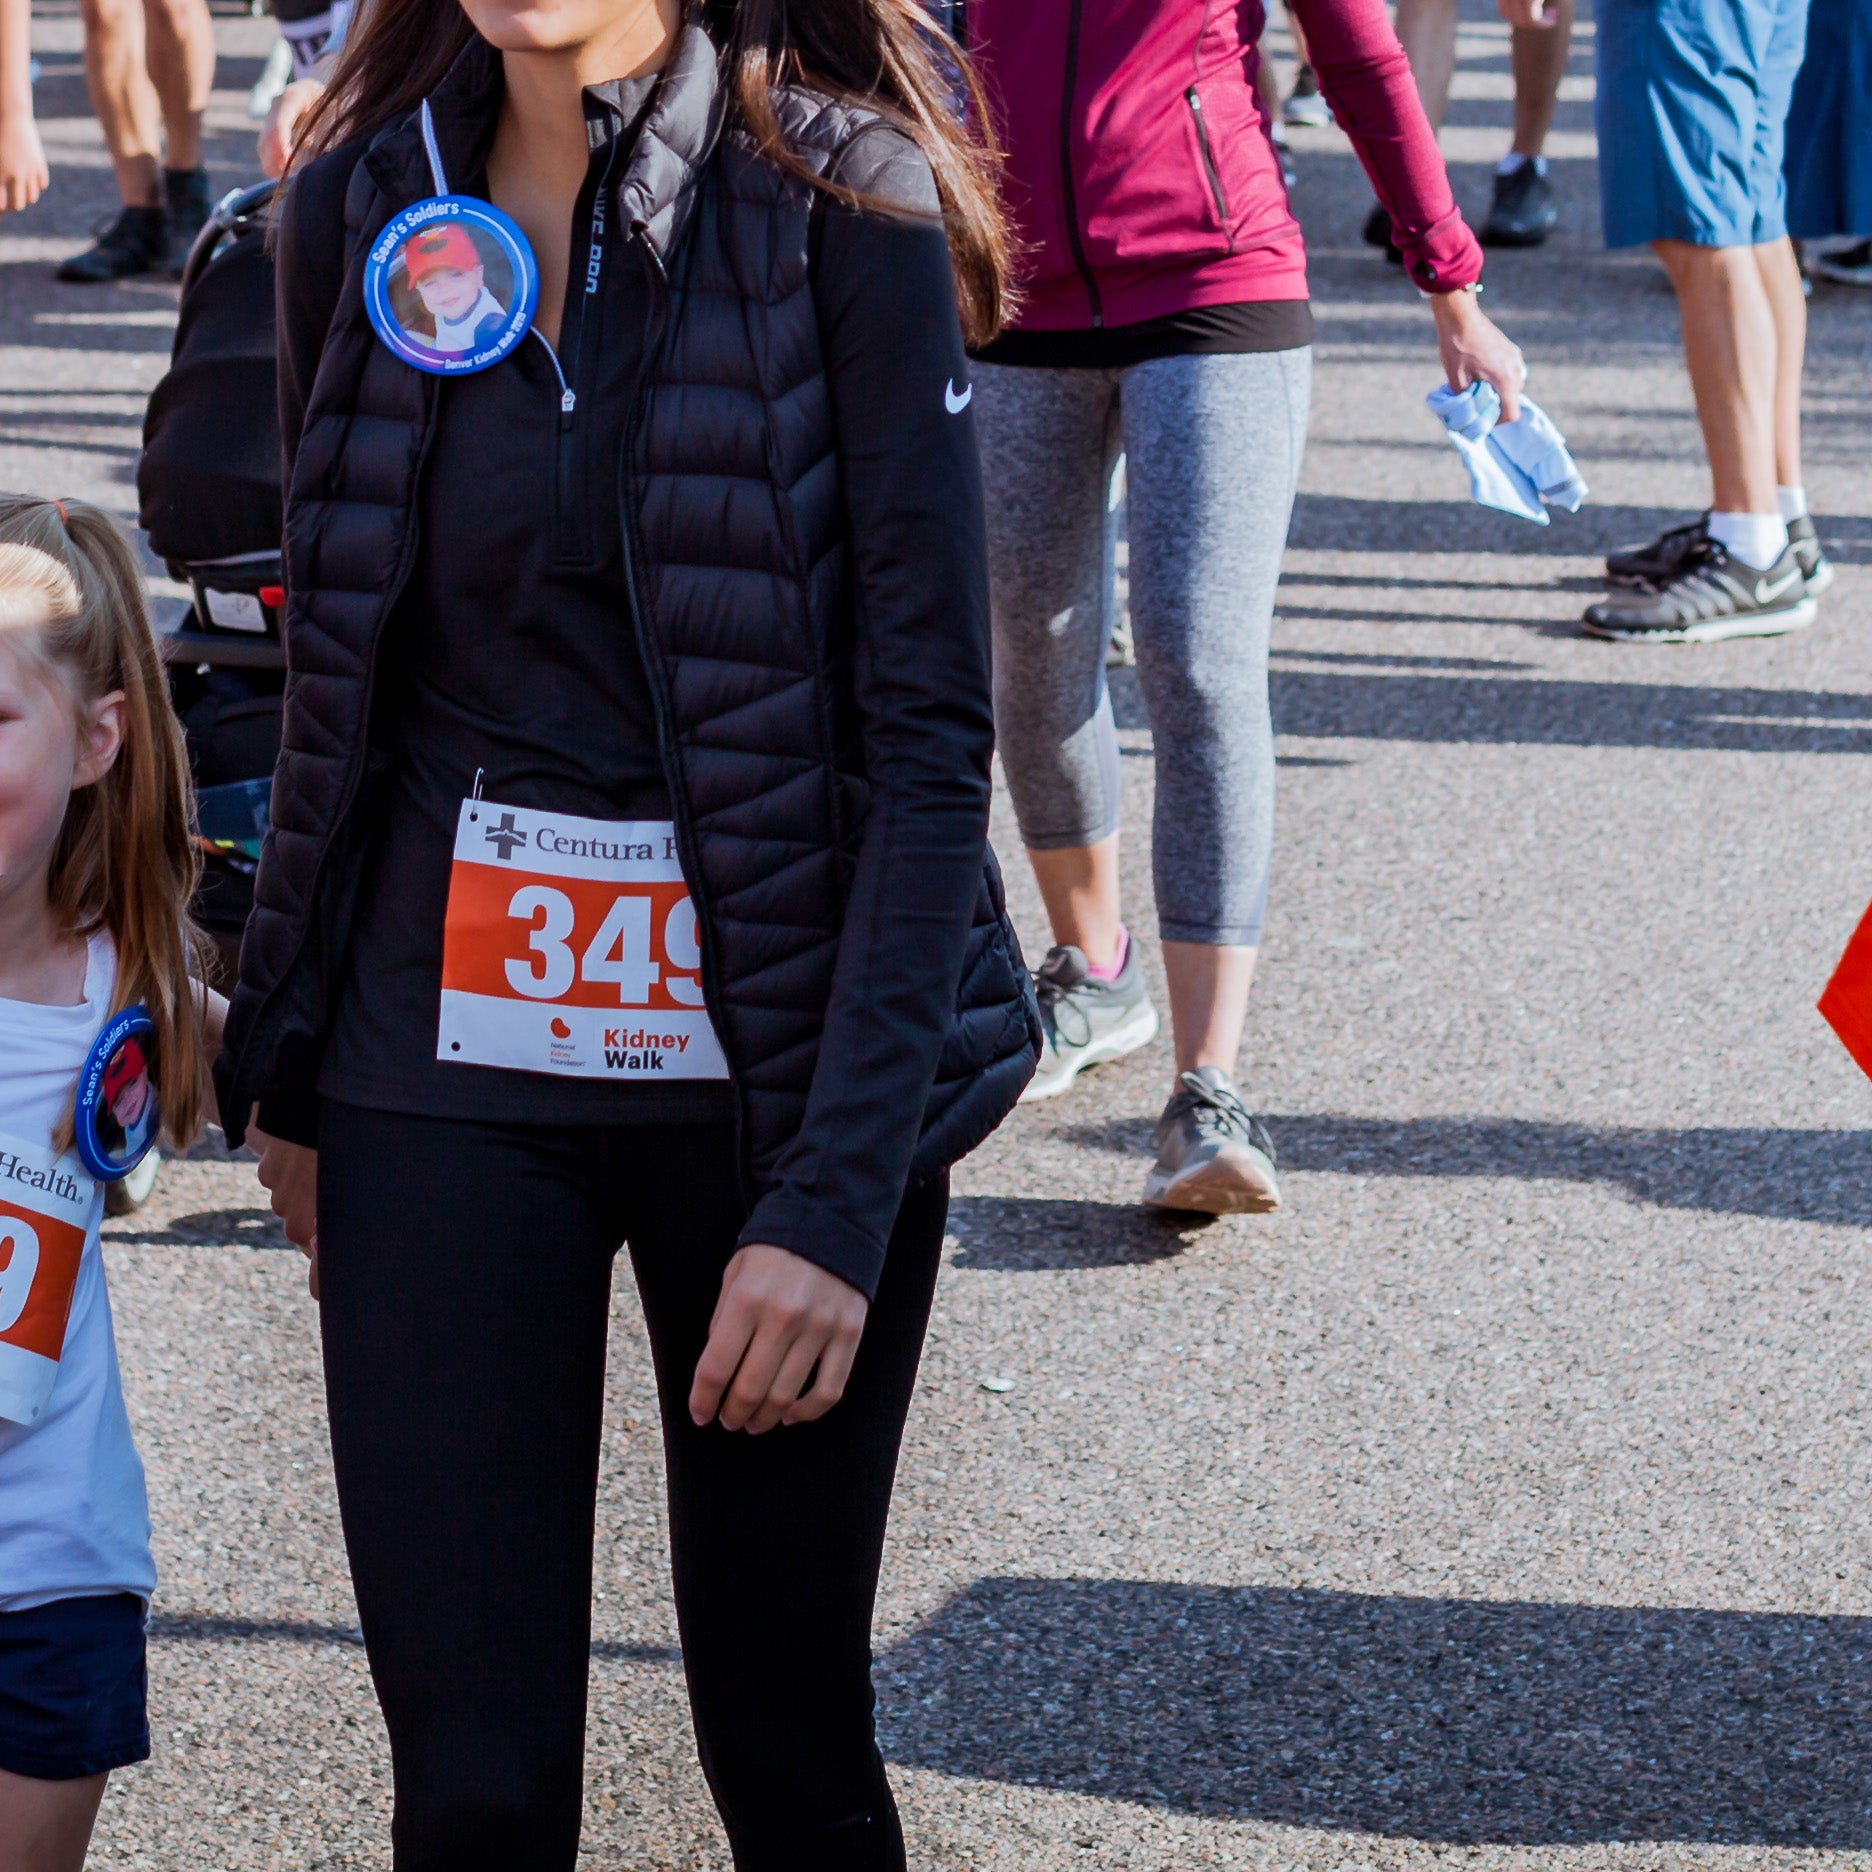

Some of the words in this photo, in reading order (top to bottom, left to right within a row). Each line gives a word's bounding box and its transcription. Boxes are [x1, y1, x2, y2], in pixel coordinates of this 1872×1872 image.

[372, 225, 407, 264] Sean's
[404, 202, 460, 227] Soldiers
[536, 828, 654, 861] Centura
[504, 885, 707, 1006] 349
[82, 1061, 103, 1105] Sean's
[98, 1018, 130, 1059] Soldiers
[604, 1028, 691, 1055] Kidney
[604, 1050, 665, 1071] Walk
